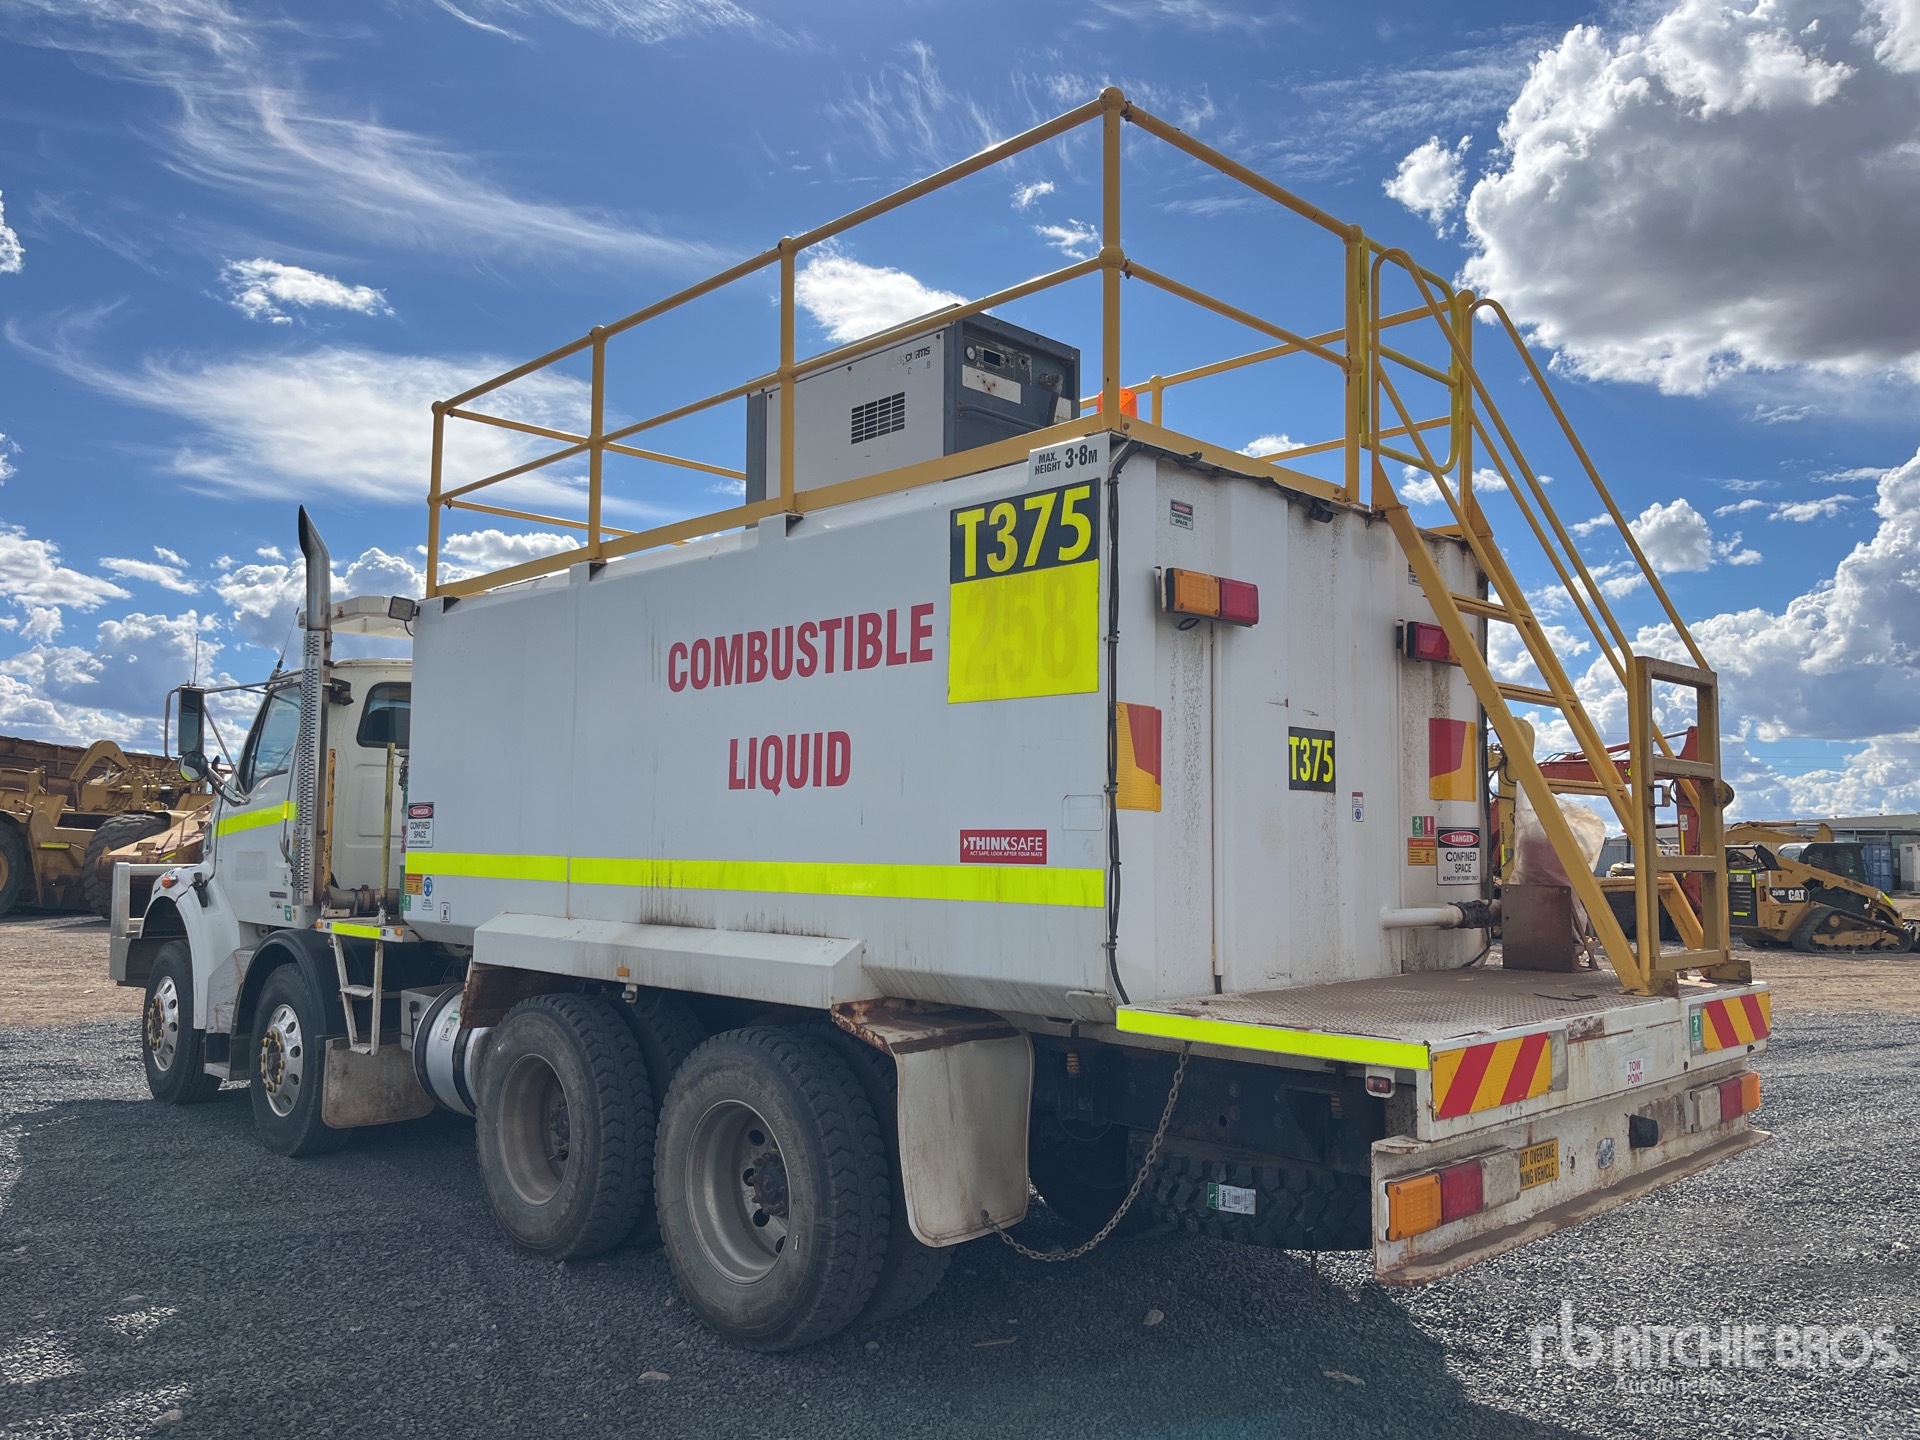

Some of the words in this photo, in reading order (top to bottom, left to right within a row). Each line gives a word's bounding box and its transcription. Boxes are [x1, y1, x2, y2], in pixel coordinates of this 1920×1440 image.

[1038, 452, 1057, 464] MAX.
[1034, 461, 1061, 475] HEIGHT
[1171, 512, 1191, 522] CONFINED
[1175, 518, 1188, 526] SPACE
[956, 485, 1092, 578] T375
[668, 602, 934, 692] COMBUSTIBLE
[728, 731, 851, 796] LIQUID
[1289, 736, 1333, 783] T375
[410, 821, 431, 830] CONFINED
[413, 830, 427, 839] SPACE
[1451, 834, 1474, 843] DANGER
[1446, 851, 1477, 862] CONFINED
[1455, 863, 1472, 873] SPACE
[1788, 889, 1805, 901] CAT
[1629, 1060, 1641, 1072] TOW
[1627, 1071, 1643, 1085] POINT
[1530, 1143, 1555, 1165] OVERTAKE
[1534, 1161, 1555, 1183] VEHICLE
